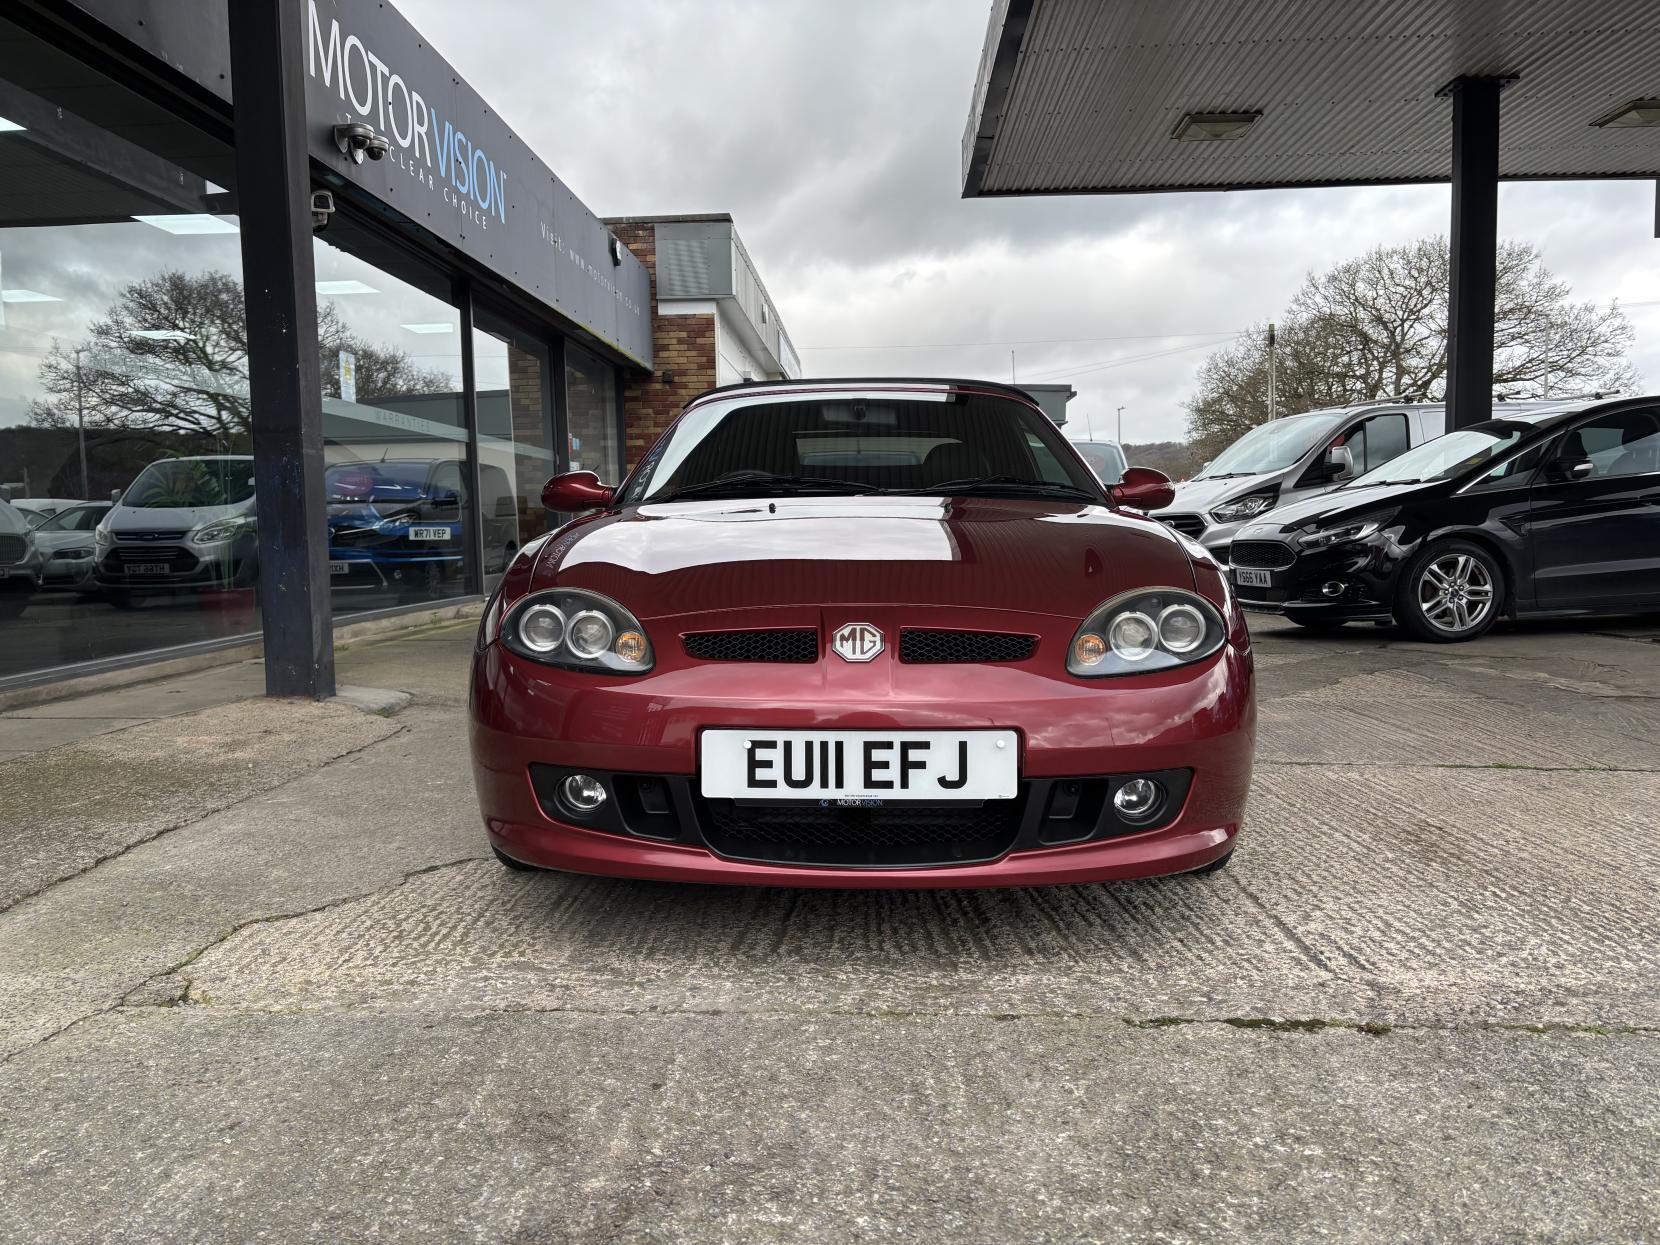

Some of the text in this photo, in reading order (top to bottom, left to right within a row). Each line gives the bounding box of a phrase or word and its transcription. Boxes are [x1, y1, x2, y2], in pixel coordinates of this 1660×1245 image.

[389, 146, 487, 230] CLEAR CHOICE
[432, 528, 447, 539] VEP
[1253, 571, 1268, 585] YAA
[839, 626, 878, 656] MG
[863, 740, 968, 790] EFJ
